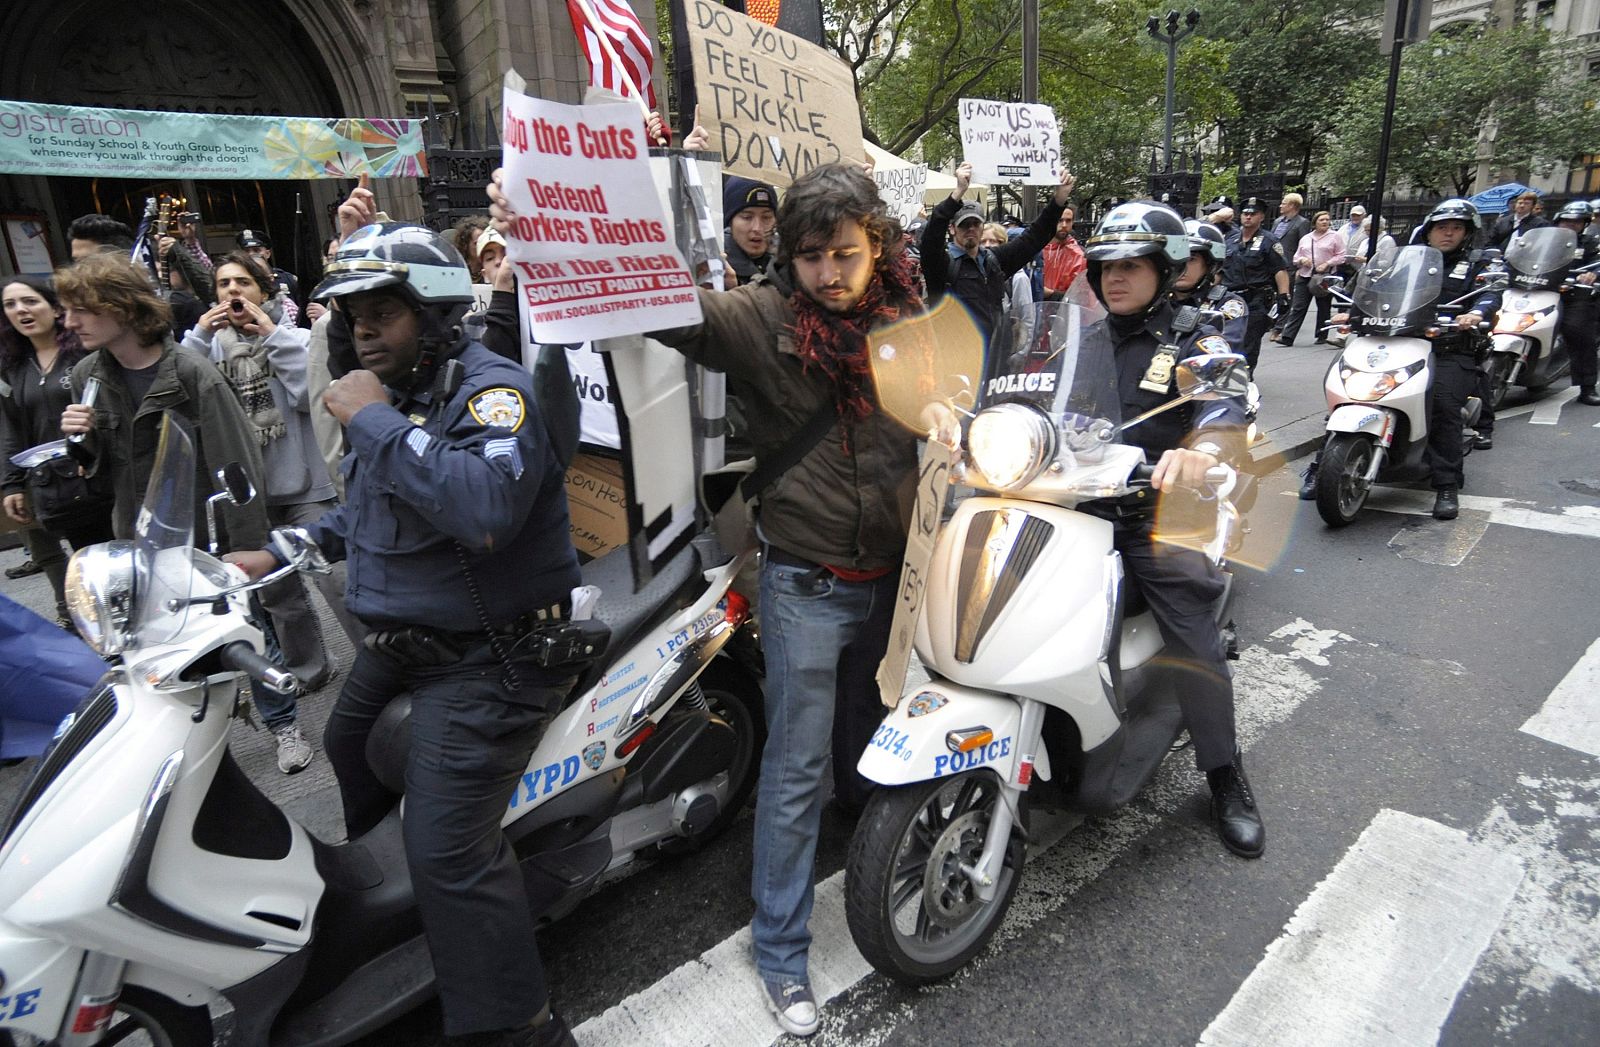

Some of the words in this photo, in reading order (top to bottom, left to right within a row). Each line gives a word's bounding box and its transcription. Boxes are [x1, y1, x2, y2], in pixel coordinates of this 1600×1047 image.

[695, 1, 733, 37] DO
[746, 22, 798, 61] YOU
[704, 38, 768, 90] FEEL
[780, 68, 809, 103] IT
[709, 82, 832, 141] TRICKLE
[977, 103, 1002, 118] NOT
[1006, 106, 1032, 132] US
[28, 134, 46, 145] for
[50, 136, 95, 150] Sunday
[99, 138, 138, 149] School
[142, 141, 151, 150] &
[153, 141, 185, 151] Youth
[188, 142, 222, 154] Group
[224, 144, 259, 154] begins
[505, 106, 528, 153] top
[532, 117, 572, 156] the
[577, 122, 637, 160] Cuts
[976, 131, 995, 142] NOT
[30, 147, 92, 159] whenever
[94, 152, 117, 161] you
[119, 152, 147, 161] walk
[150, 152, 194, 164] through
[197, 153, 214, 163] the
[216, 154, 249, 163] doors!
[527, 178, 608, 214] Defend
[591, 217, 666, 246] Rights
[515, 261, 567, 279] Tax
[567, 259, 614, 276] the
[616, 254, 680, 271] Rich
[1515, 275, 1549, 285] POLICE
[527, 281, 603, 303] SOCIALIST
[605, 276, 655, 293] PARTY
[658, 274, 691, 286] USA
[533, 293, 694, 323] WWW.SOCIALISTPARTY-USA.ORG
[1361, 316, 1407, 327] POLICE
[986, 373, 1056, 397] POLICE
[656, 648, 665, 658] 1
[666, 630, 690, 652] PCT
[934, 736, 1011, 777] POLICE
